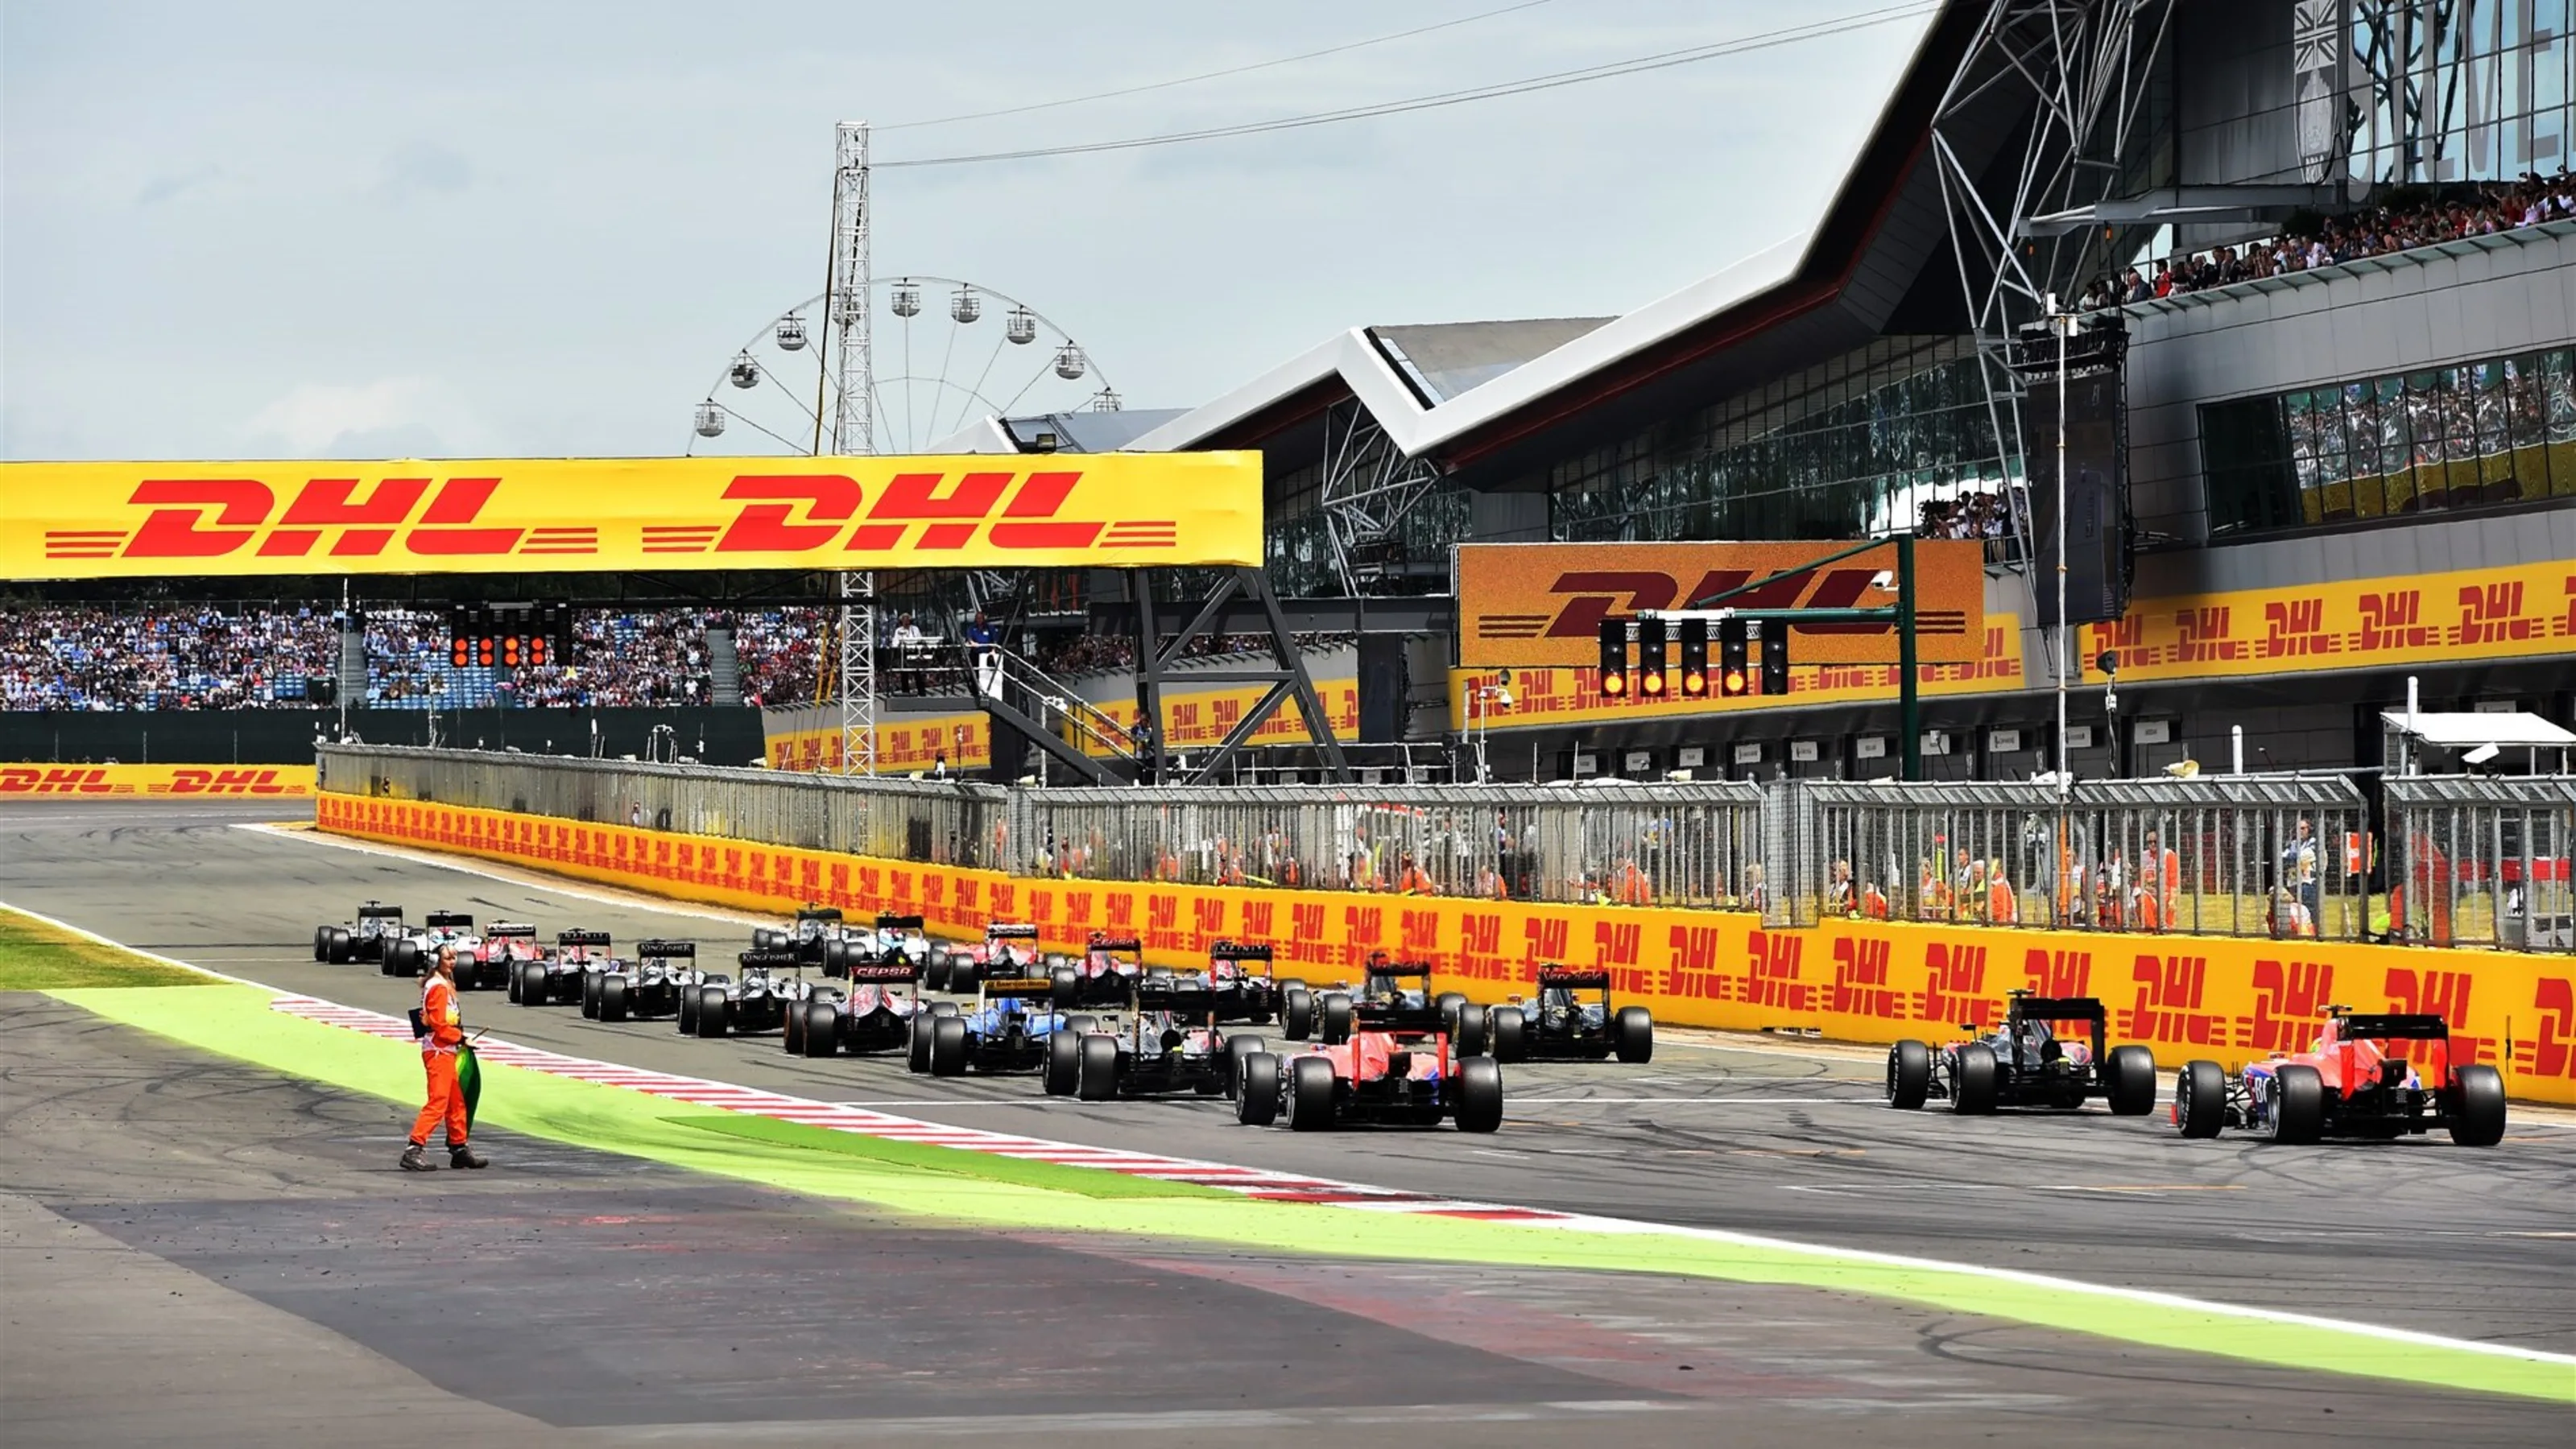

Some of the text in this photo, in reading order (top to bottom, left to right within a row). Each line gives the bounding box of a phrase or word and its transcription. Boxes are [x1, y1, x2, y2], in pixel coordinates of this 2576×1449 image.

[122, 477, 524, 557] DHL
[715, 472, 1106, 552] DHL
[1544, 570, 1894, 637] DHL
[2176, 606, 2236, 663] DHL
[2265, 598, 2329, 658] DHL
[2359, 590, 2426, 650] DHL
[2458, 580, 2530, 645] DHL
[1172, 703, 1201, 739] DHL
[1519, 670, 1557, 713] DHL
[0, 769, 113, 793] DHL
[170, 770, 283, 794] DHL
[1148, 894, 1179, 950] DHL
[1292, 903, 1327, 964] DHL
[1461, 912, 1503, 980] DHL
[1594, 921, 1644, 993] DHL
[1668, 925, 1722, 999] DHL
[1747, 931, 1806, 1011] DHL
[1833, 937, 1893, 1018] DHL
[1925, 943, 1991, 1026] DHL
[2131, 955, 2211, 1045] DHL
[2251, 960, 2334, 1052] DHL
